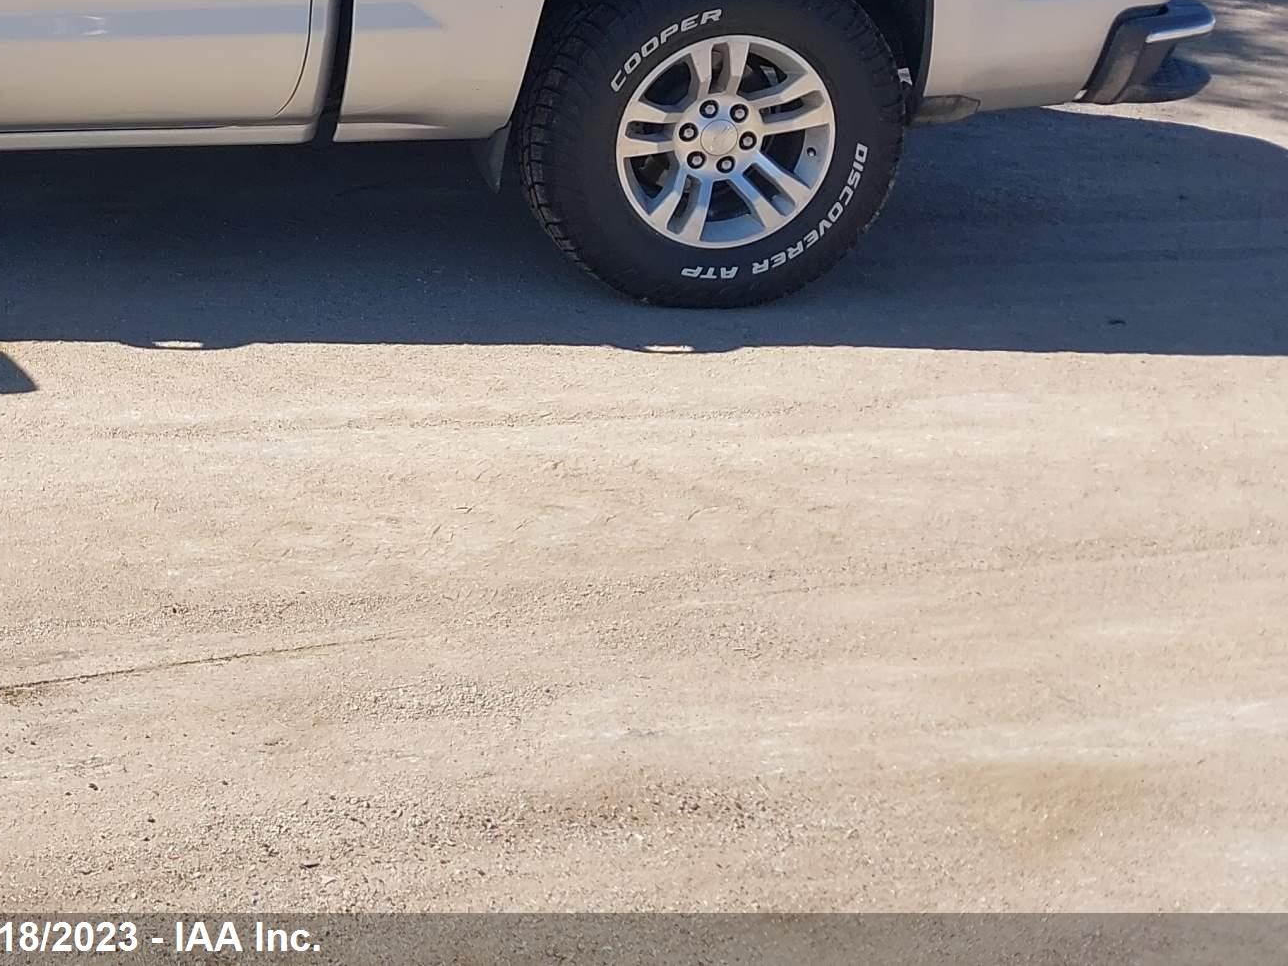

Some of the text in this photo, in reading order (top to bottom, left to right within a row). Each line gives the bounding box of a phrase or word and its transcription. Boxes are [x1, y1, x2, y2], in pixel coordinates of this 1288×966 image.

[611, 9, 722, 92] COOPER
[681, 143, 868, 279] DISCOVERER ATP
